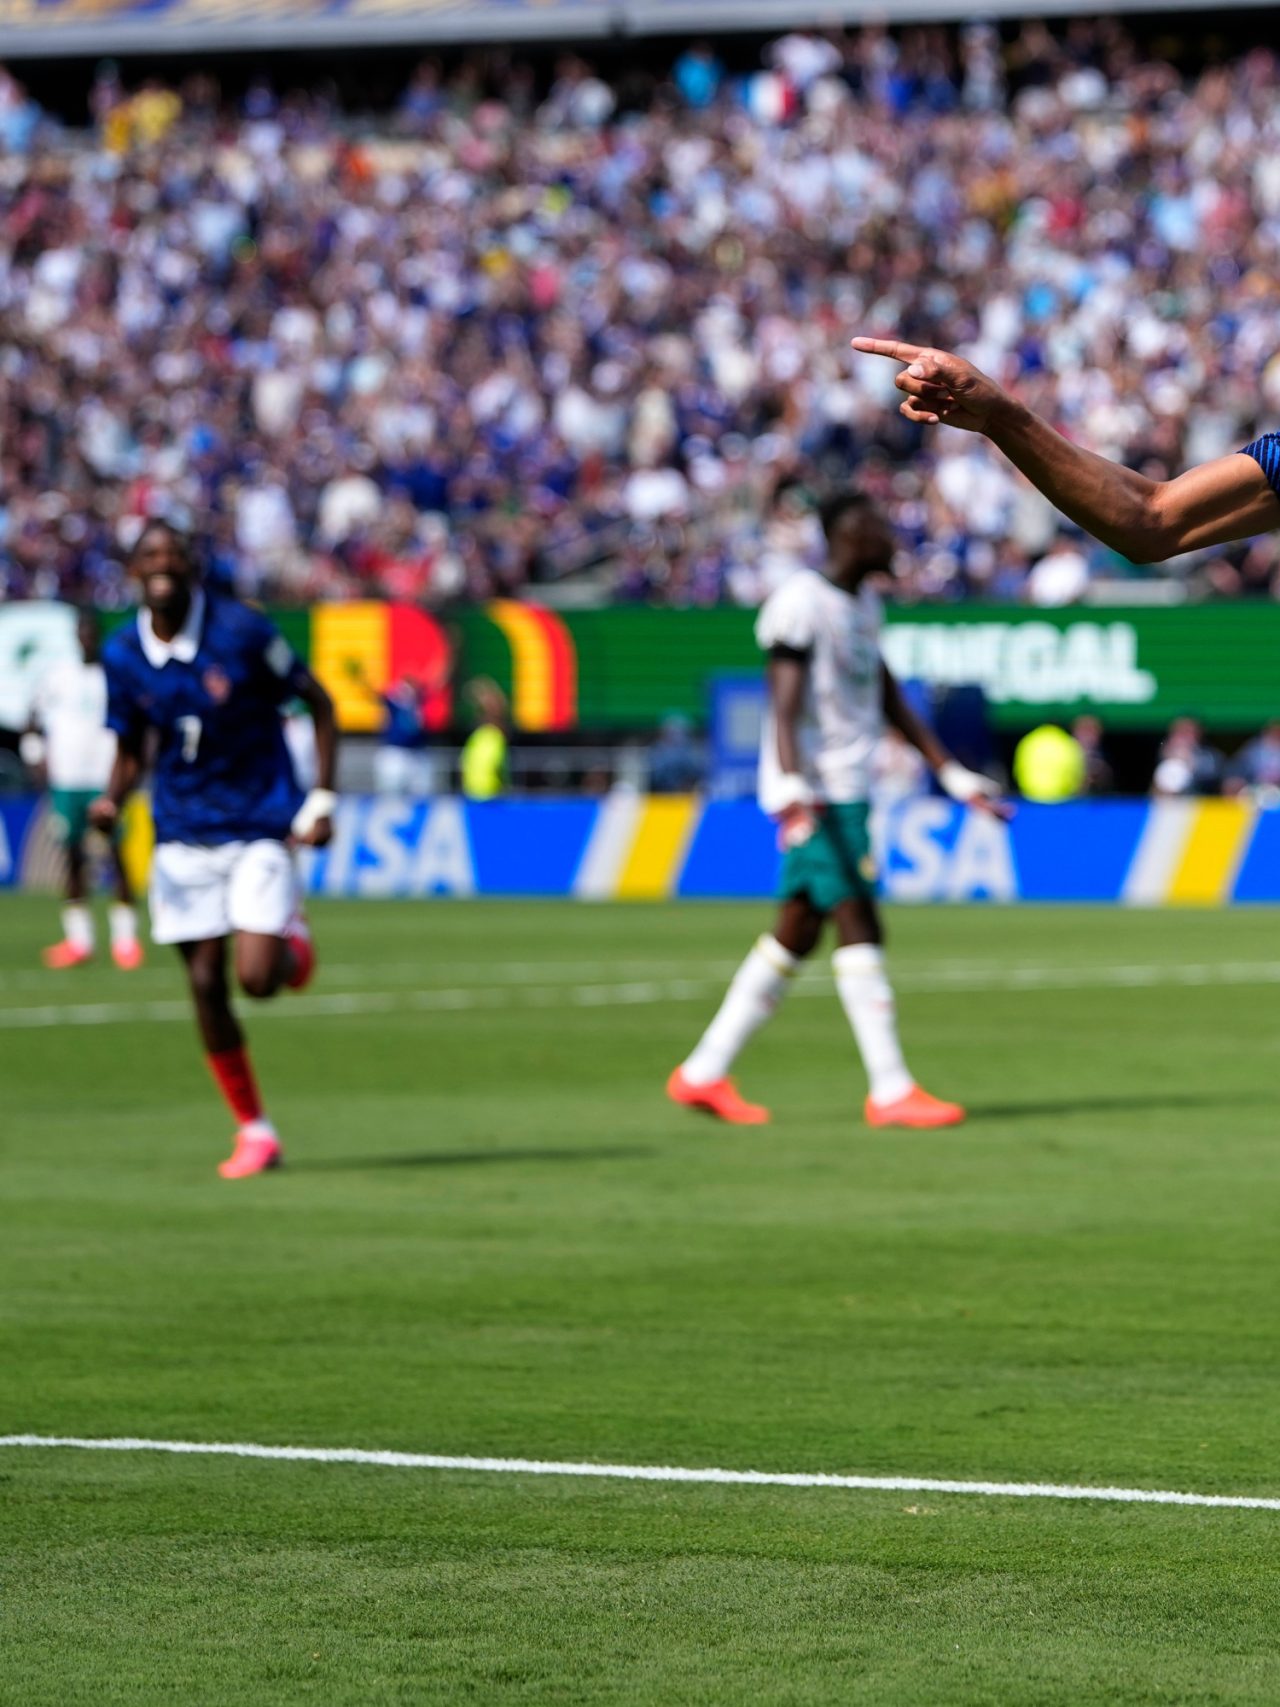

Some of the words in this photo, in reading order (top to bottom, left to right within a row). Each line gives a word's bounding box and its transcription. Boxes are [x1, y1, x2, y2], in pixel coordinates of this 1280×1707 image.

[882, 621, 1157, 703] ENEGAL
[298, 797, 479, 898] ISA
[867, 799, 1018, 903] ISA
